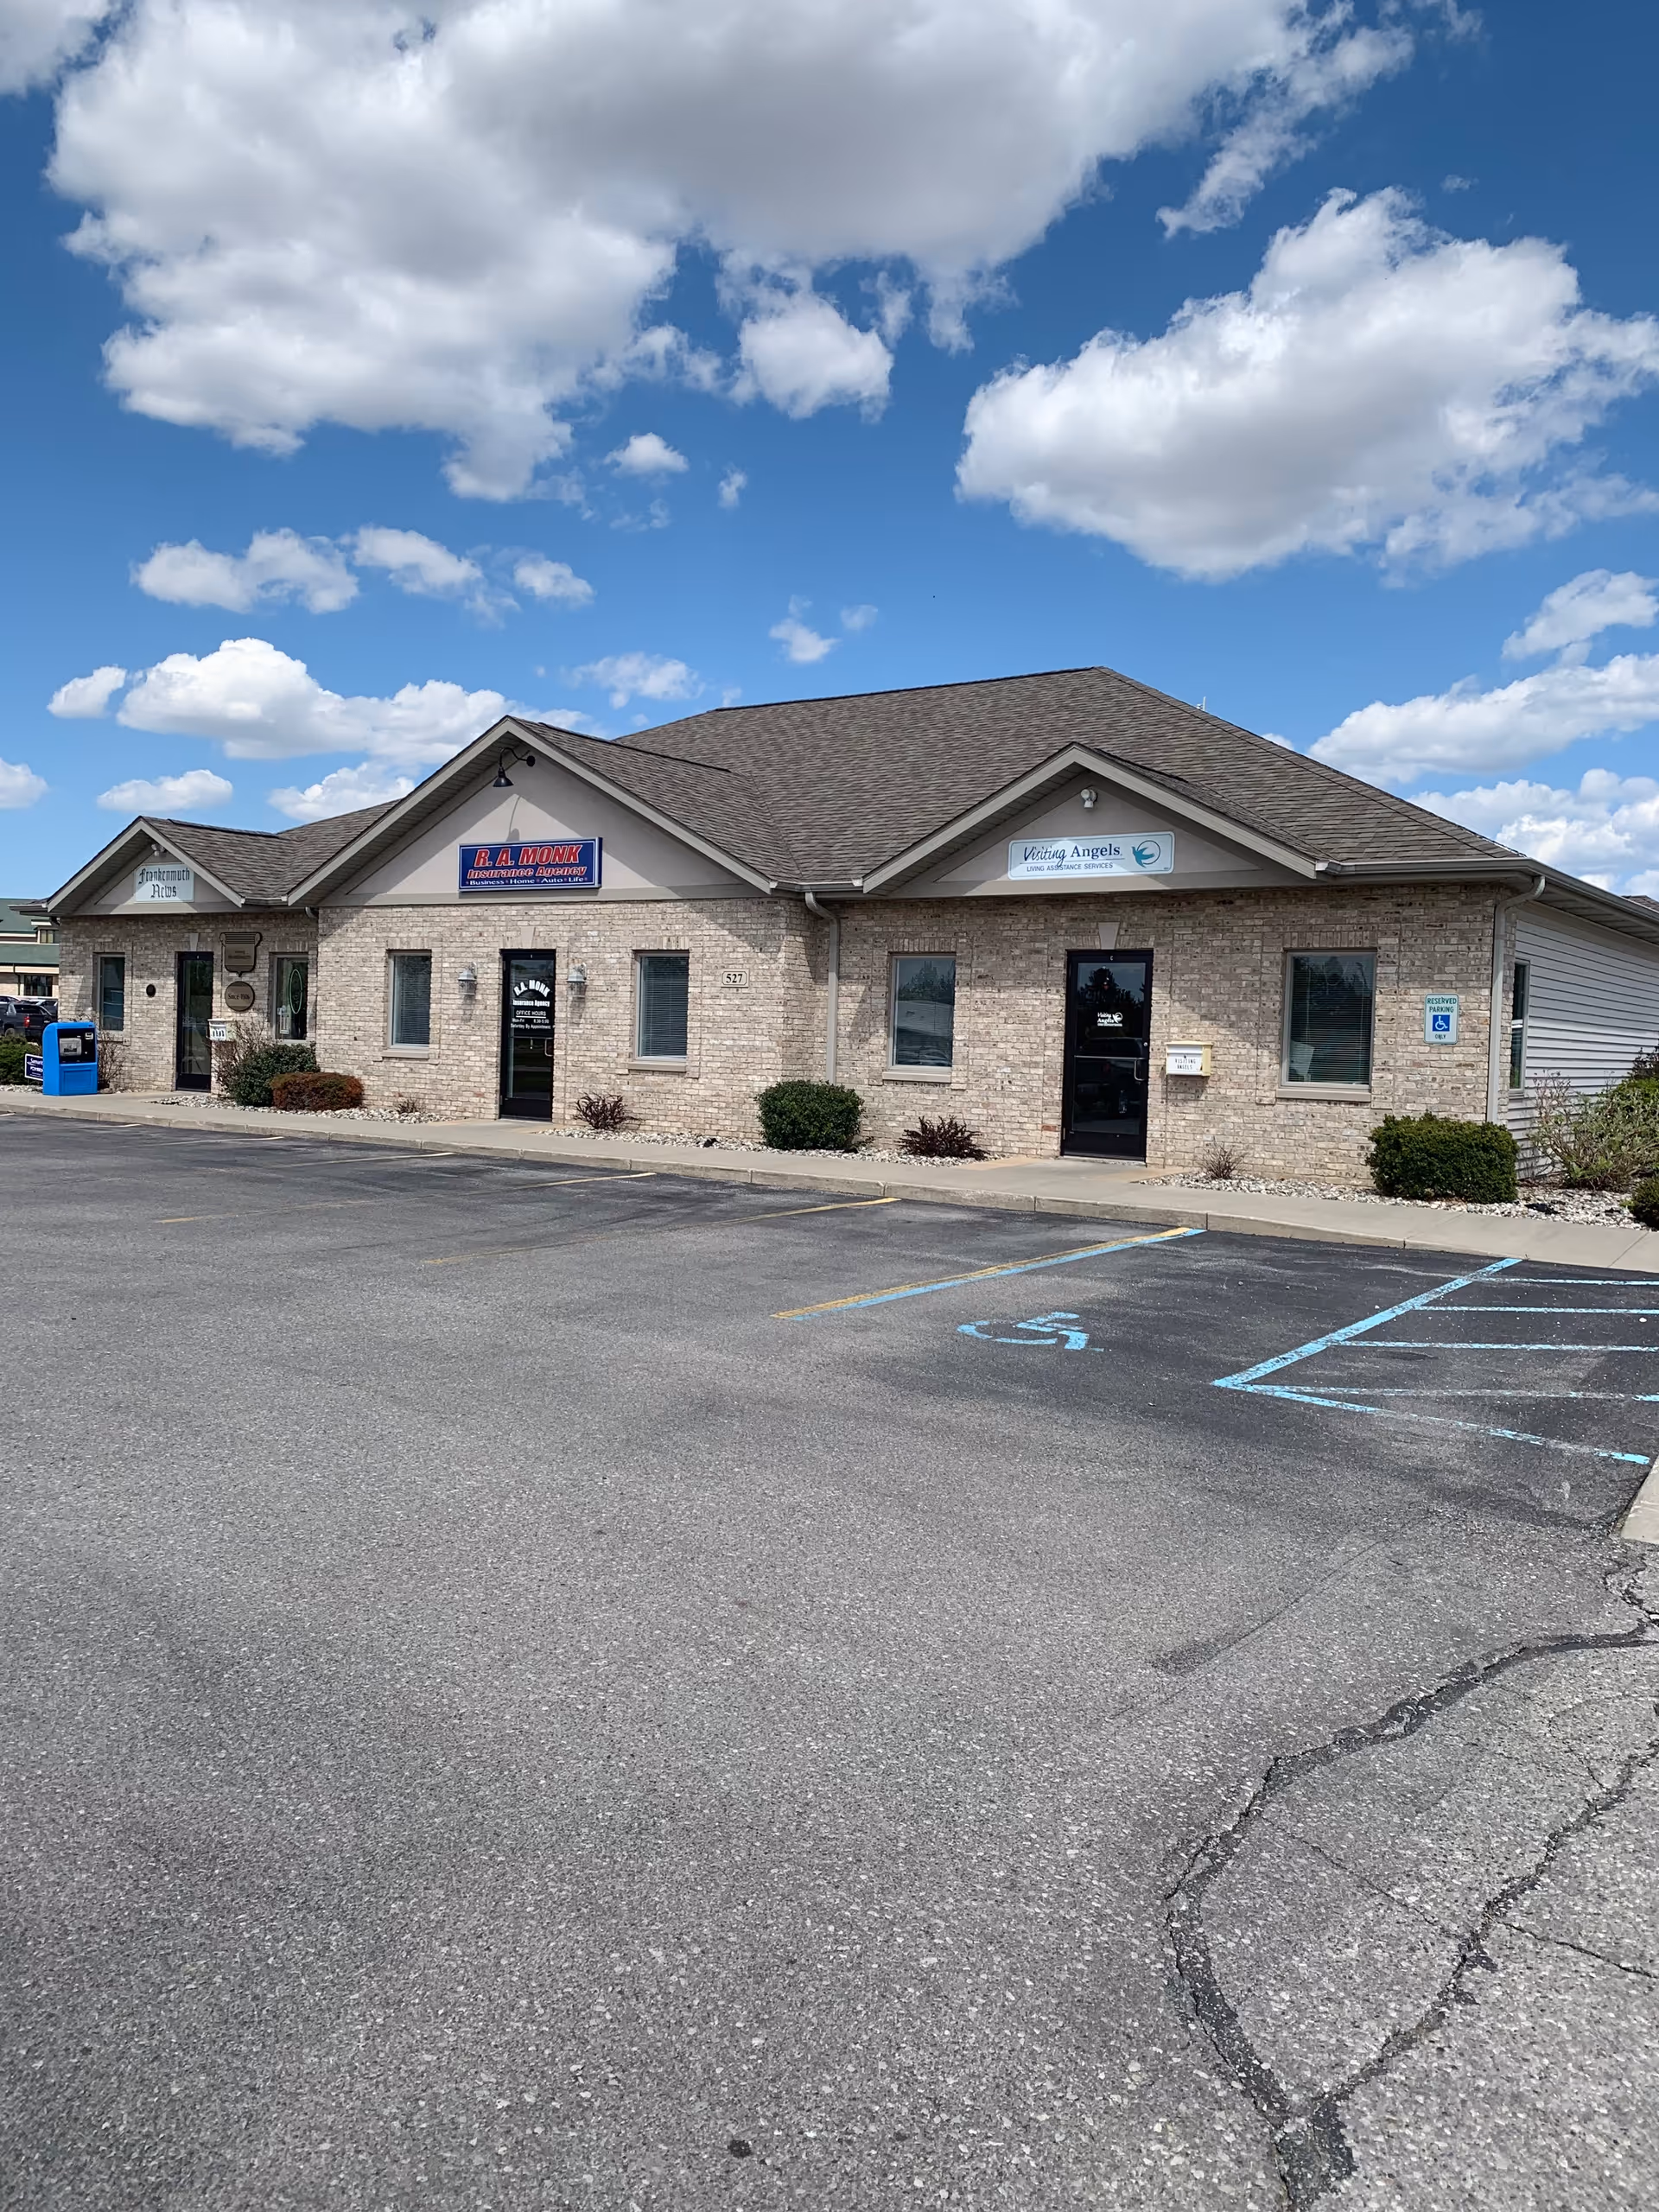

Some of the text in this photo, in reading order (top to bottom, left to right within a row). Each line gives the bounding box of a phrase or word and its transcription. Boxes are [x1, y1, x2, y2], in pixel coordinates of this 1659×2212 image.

[474, 845, 582, 867] R. A. MONK
[1024, 843, 1121, 868] Visiting Angels
[138, 868, 190, 884] Frankenmuth
[467, 866, 587, 879] Insurance Agency
[150, 883, 177, 899] News
[726, 973, 743, 983] 527
[529, 979, 550, 997] MONK
